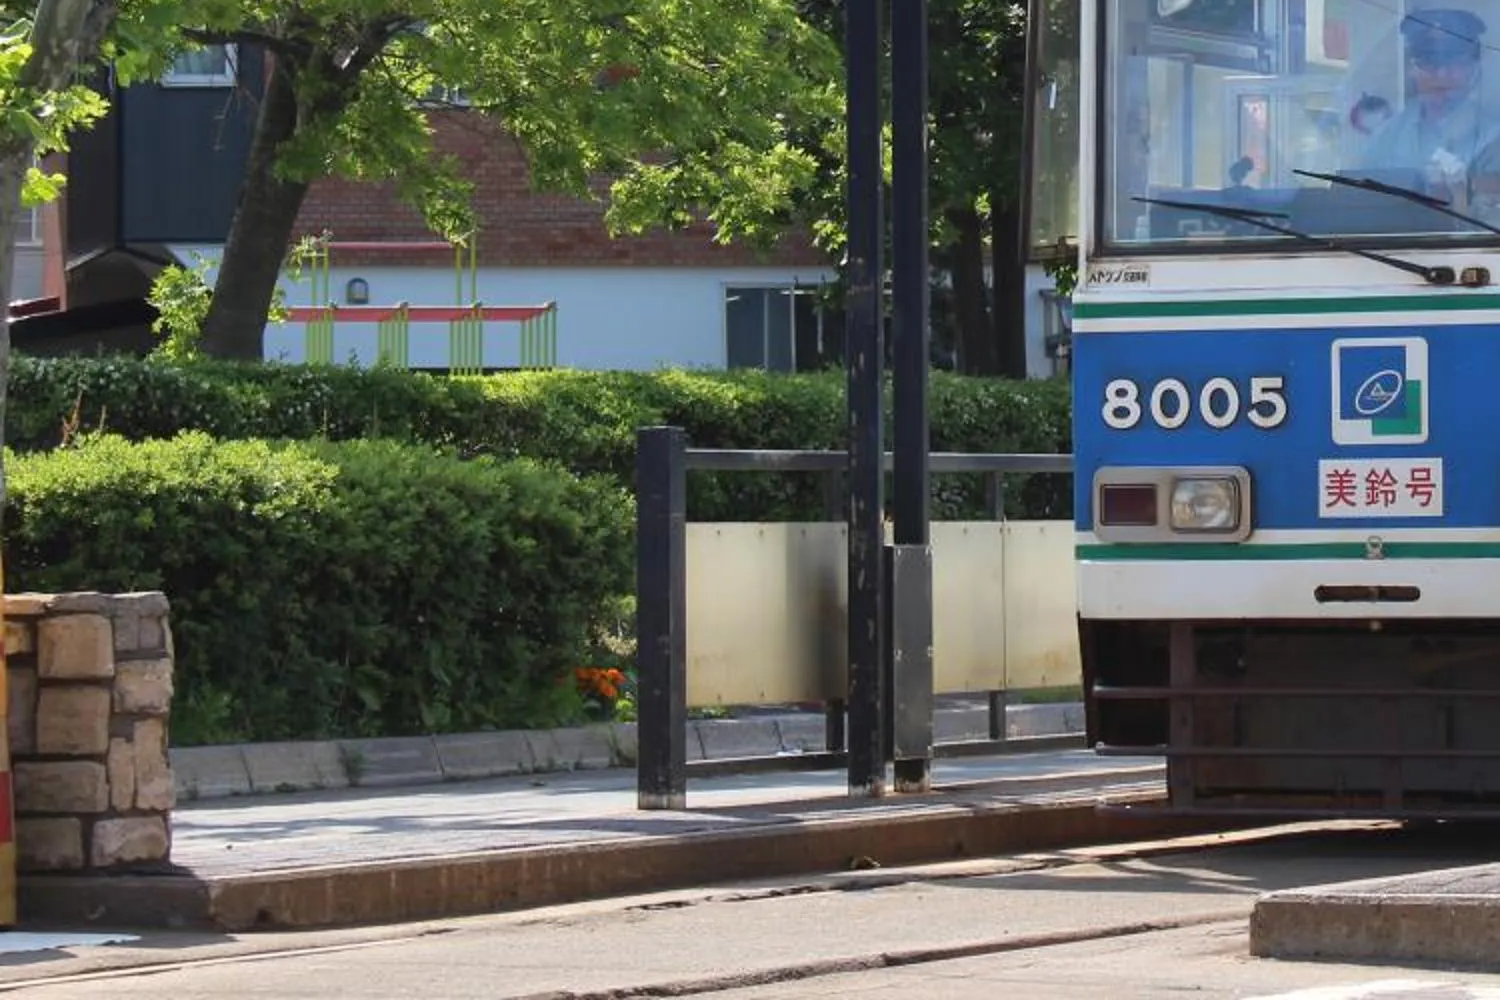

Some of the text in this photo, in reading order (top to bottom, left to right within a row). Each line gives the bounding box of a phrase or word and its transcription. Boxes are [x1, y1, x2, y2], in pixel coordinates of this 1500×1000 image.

[1100, 375, 1289, 430] 8005
[1325, 468, 1437, 508] 美鈴号
